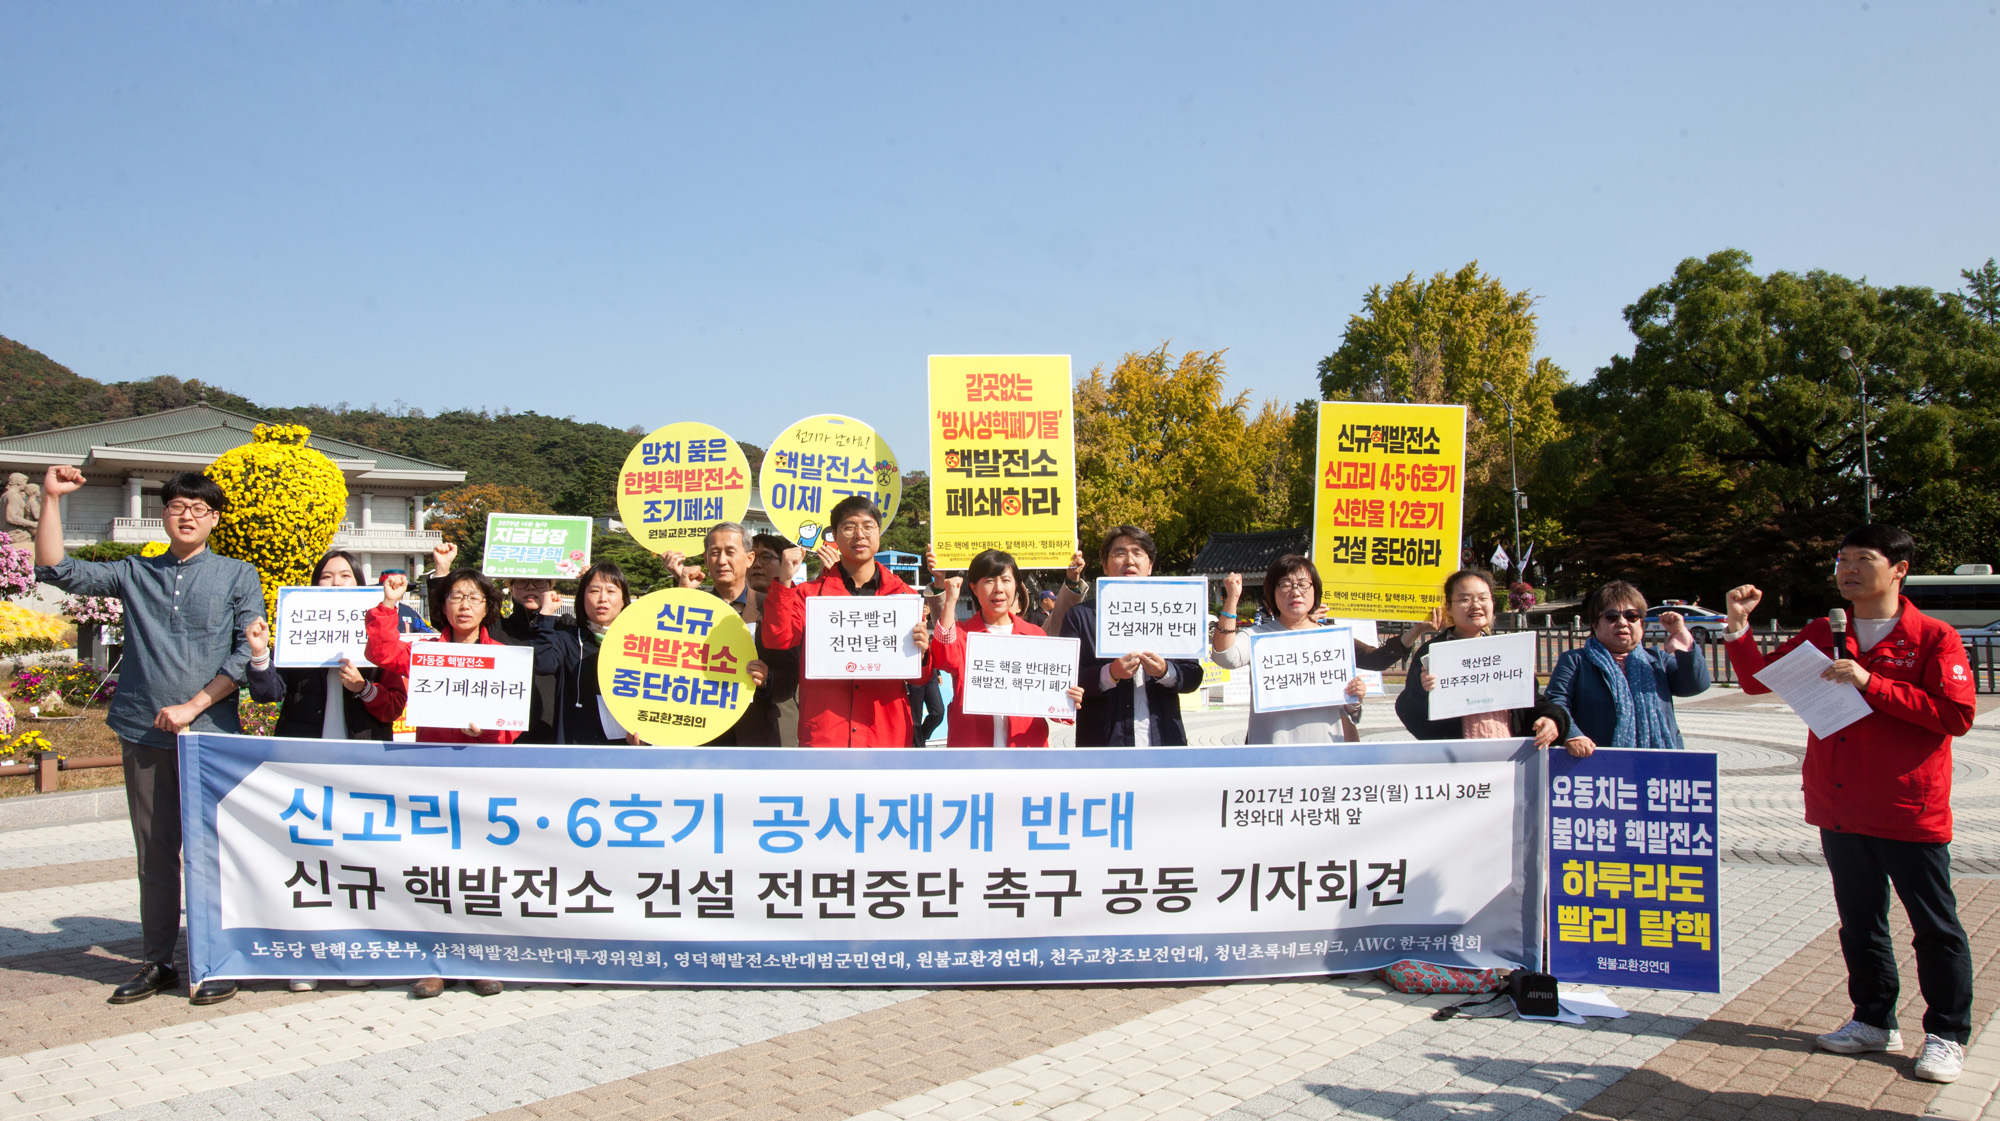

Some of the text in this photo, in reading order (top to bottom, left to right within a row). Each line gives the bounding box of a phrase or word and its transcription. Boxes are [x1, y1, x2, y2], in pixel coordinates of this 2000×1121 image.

[966, 373, 1033, 402] 갈곳없는
[937, 410, 1063, 440] '방사성핵폐기물'
[796, 429, 830, 444] 전기가
[1338, 424, 1440, 454] 신규핵발전소
[642, 438, 727, 465] 망치 품은
[775, 450, 874, 485] 핵발전소
[945, 449, 1058, 478] 핵발전소
[624, 467, 744, 496] 한빛핵발전소
[1325, 461, 1376, 490] 신고리
[643, 496, 724, 523] 조기폐쇄
[772, 483, 821, 514] 이제
[946, 487, 1061, 517] 폐쇄하라
[1333, 499, 1385, 528] 신한울
[493, 527, 568, 545] 지금당장
[937, 541, 952, 550] 모든
[954, 541, 970, 550] 핵에
[488, 545, 564, 563] 즉각탈핵
[1333, 536, 1442, 567] 건설 중단하라
[1333, 591, 1349, 600] 핵에
[290, 609, 367, 624] 신고리 5,6
[1107, 600, 1197, 616] 신고리 5,6호기
[657, 604, 714, 636] 신규
[829, 609, 897, 630] 하루빨리
[1107, 621, 1197, 637] 건설재개 반대
[289, 630, 369, 645] 건설재개 반
[829, 634, 898, 653] 전면탈핵
[417, 655, 485, 668] 가동중 핵발전소
[623, 633, 738, 674] 핵발전소
[1261, 649, 1346, 669] 신고리 5,6호기
[1461, 654, 1502, 670] 핵산업은
[859, 663, 881, 672] 노동당
[972, 660, 1072, 676] 모든 핵을 반대한다
[413, 677, 527, 700] 조기폐쇄하라
[612, 668, 739, 710] 중단하라!
[971, 676, 1071, 692] 핵발전, 핵무기 폐기
[1263, 672, 1316, 691] 건설재개
[1320, 669, 1348, 684] 반대
[1440, 668, 1523, 690] 민주주의가 아니다
[506, 719, 523, 727] 노동당
[637, 710, 706, 728] 종교환경회의
[1234, 782, 1491, 804] 2017년 10월 23일(월) 11시 30분
[1552, 775, 1713, 813] 요동치는 한반도
[279, 785, 462, 850] 신고리
[753, 792, 994, 854] 공사재개
[1021, 791, 1135, 851] 반대
[1233, 807, 1362, 828] 청와대 사랑채 앞
[1552, 817, 1713, 856] 불안한 핵발전소
[284, 858, 1407, 920] 신규 핵발전소 건설 전면중단 촉구 공동 기자회견
[1562, 860, 1705, 903] 하루라도
[1557, 905, 1711, 951] 빨리 탈핵
[251, 934, 1481, 971] 노동당 탈핵운동본부, 삼척핵발전소반대투쟁위원회, 영덕핵발전소반대범군민연대, 원불교환경연대, 천주교창조보전연대, 청년초록네트워크, AWC 한국위원회
[1596, 957, 1670, 974] 원불교환경연대
